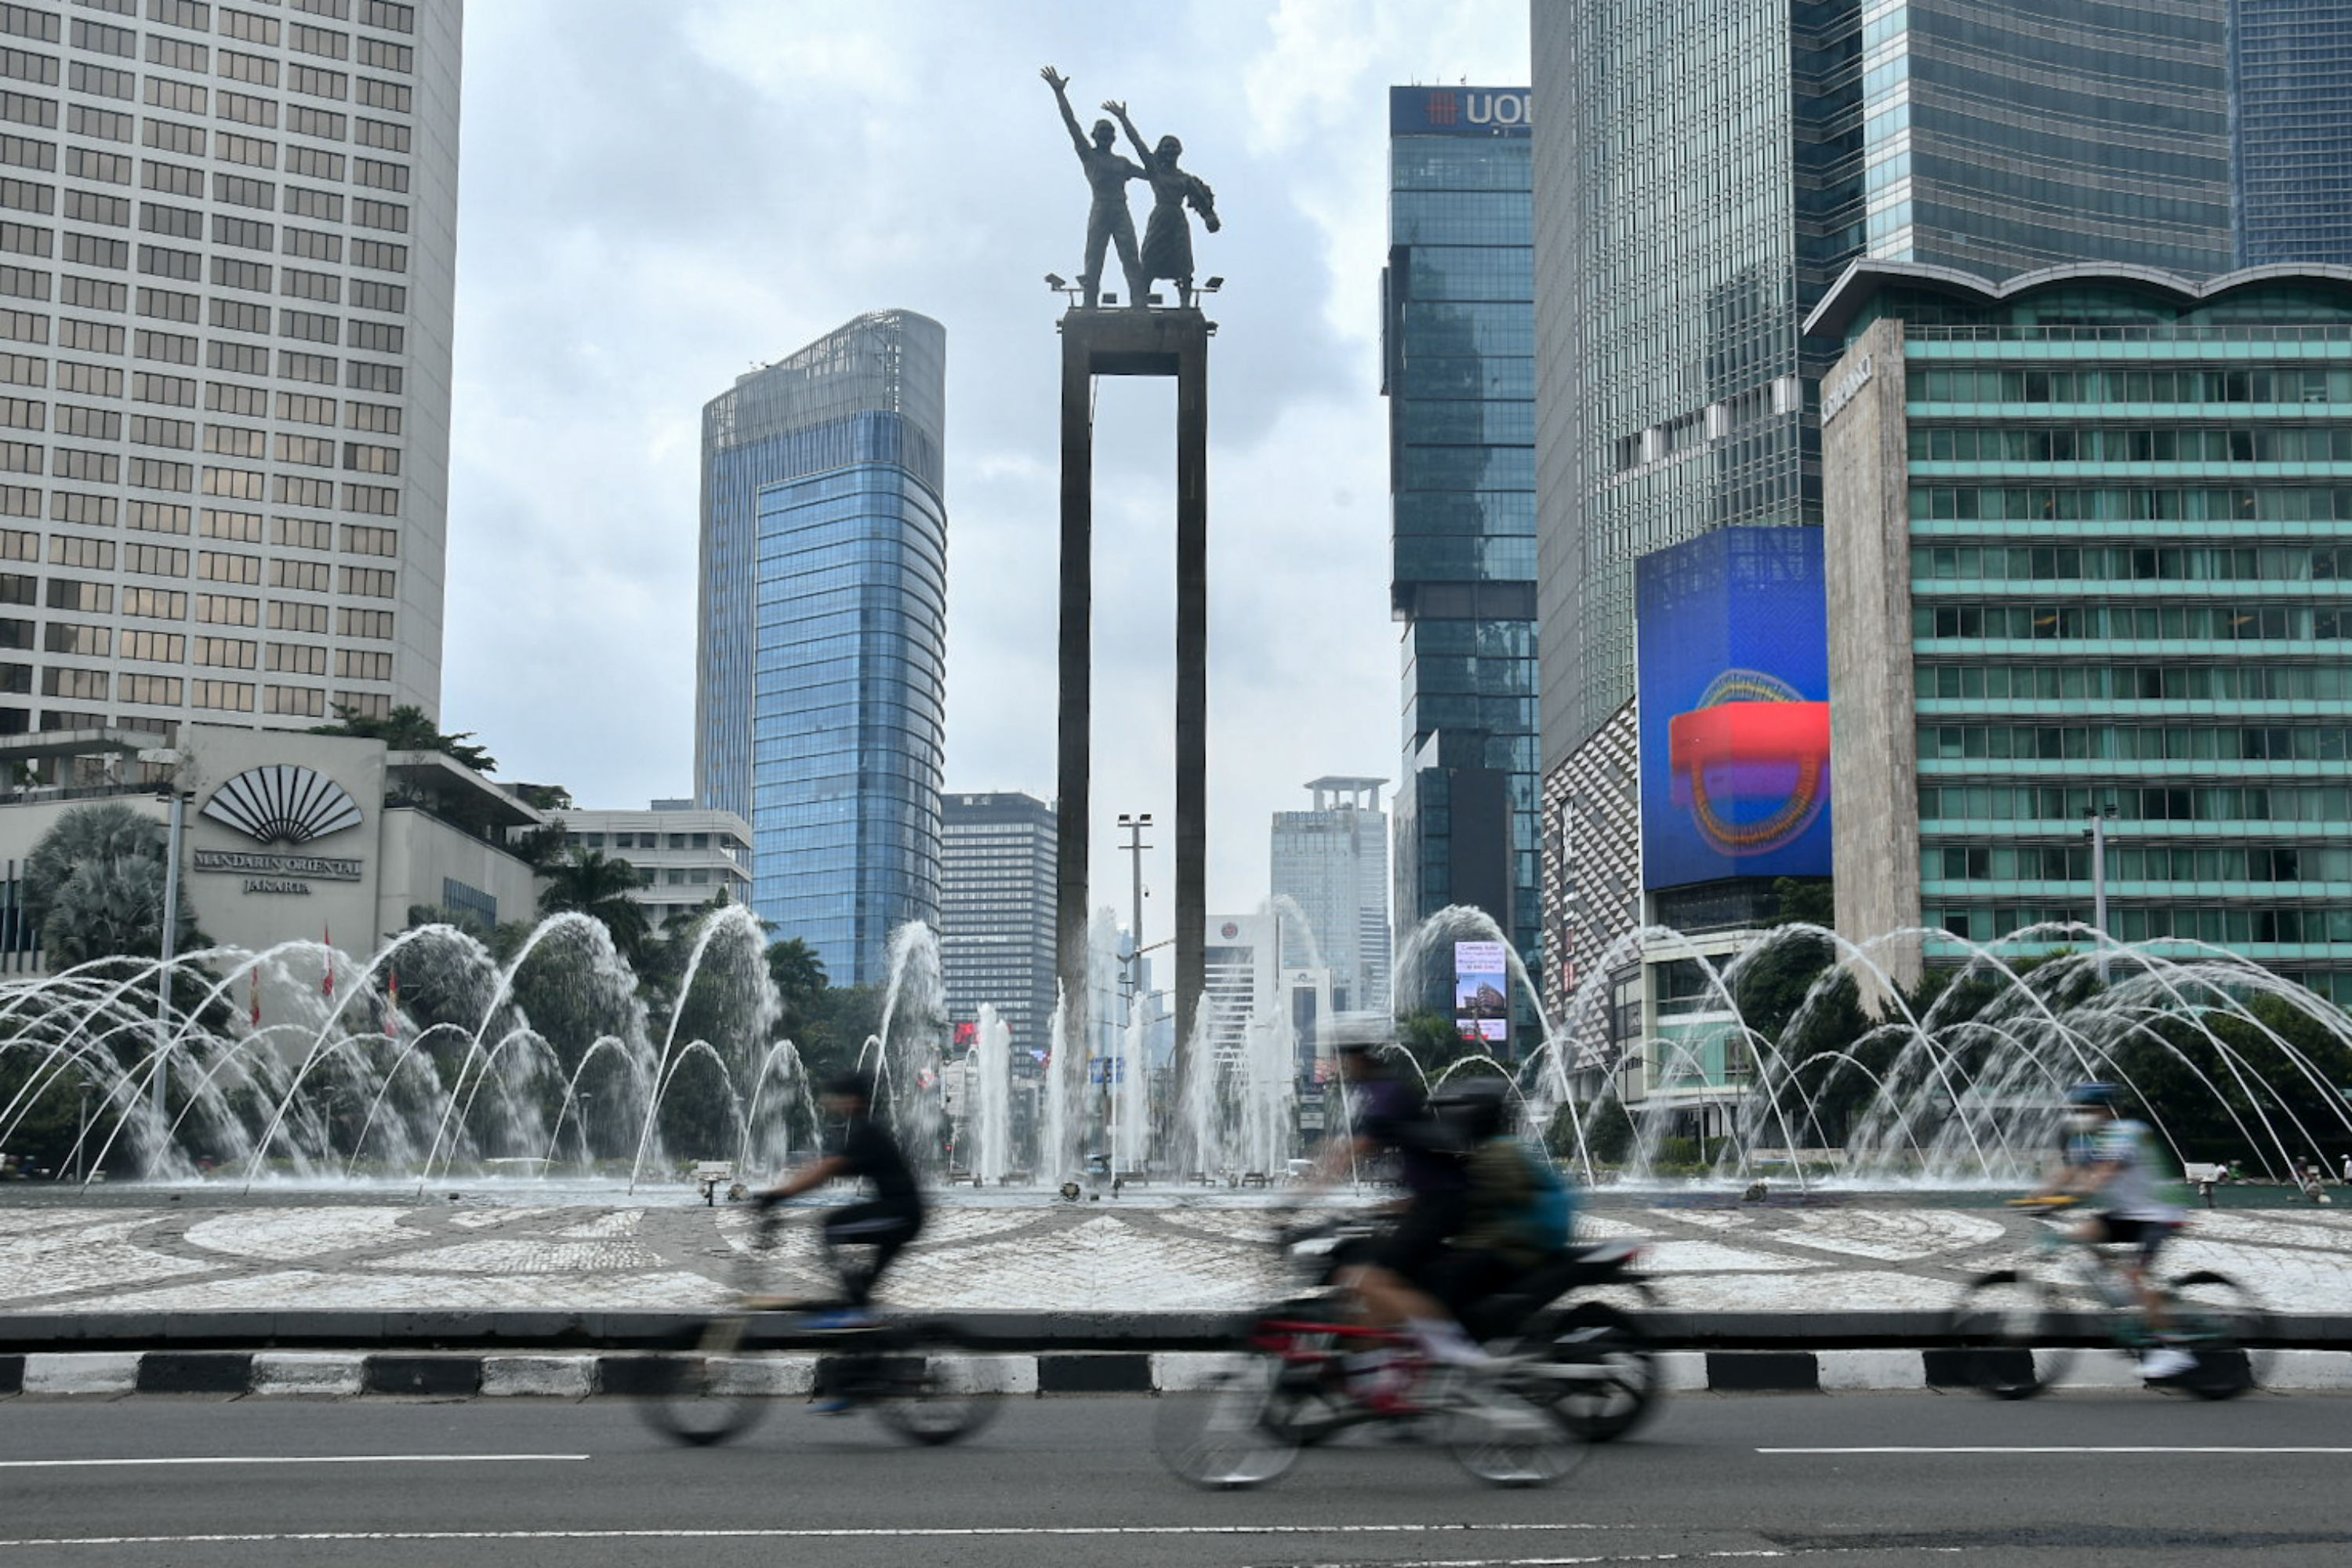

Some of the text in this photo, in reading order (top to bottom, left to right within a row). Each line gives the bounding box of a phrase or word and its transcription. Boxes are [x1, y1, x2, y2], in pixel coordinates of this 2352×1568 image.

[196, 853, 361, 874] MANDARIN ORIENTAL
[245, 879, 311, 894] JAKARTA
